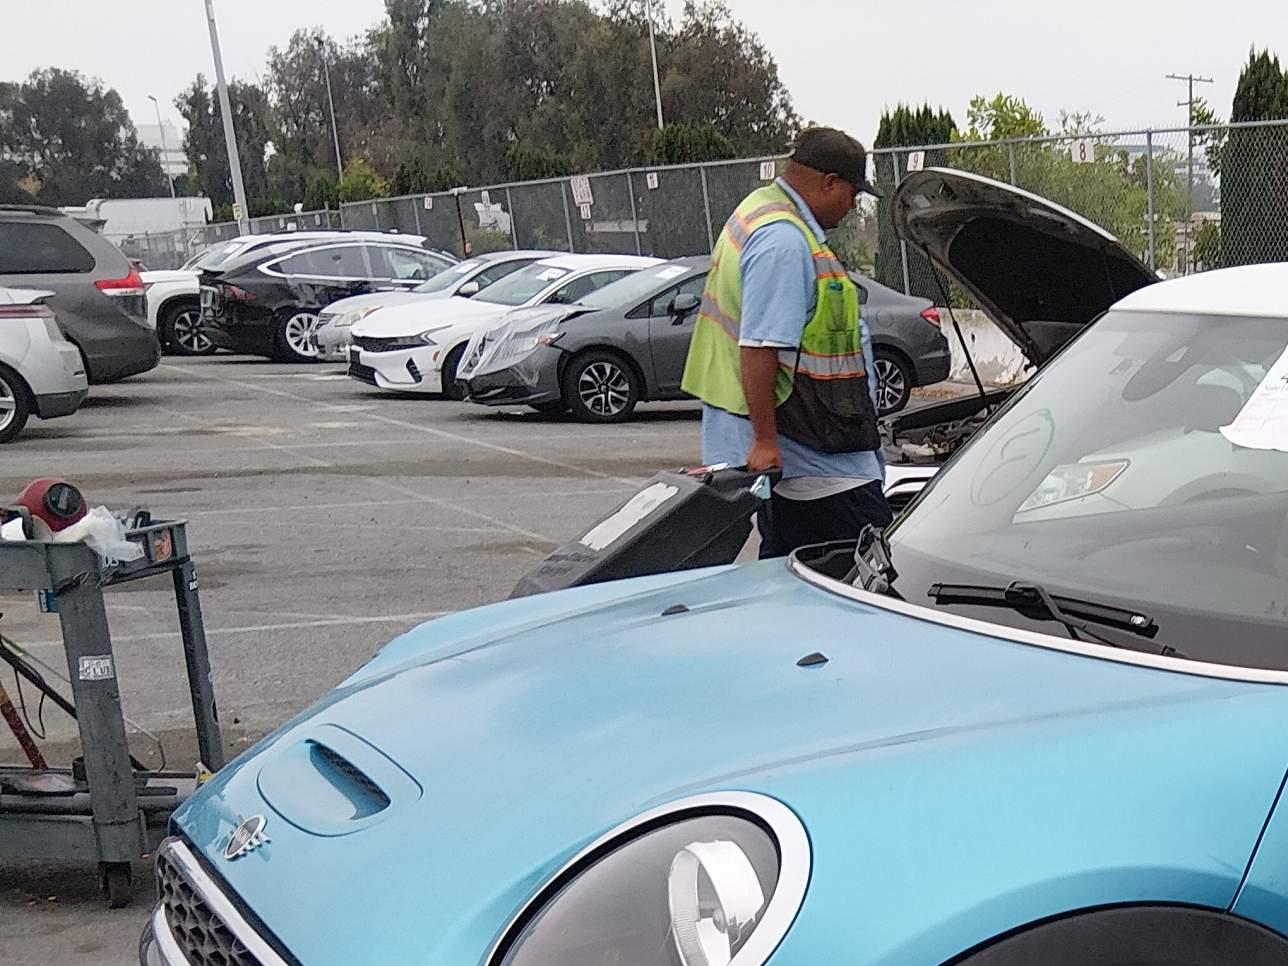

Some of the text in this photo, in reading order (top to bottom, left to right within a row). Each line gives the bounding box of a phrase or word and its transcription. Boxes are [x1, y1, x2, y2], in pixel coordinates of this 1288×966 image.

[1080, 142, 1086, 161] 8
[912, 153, 919, 169] 9
[764, 162, 773, 178] 10
